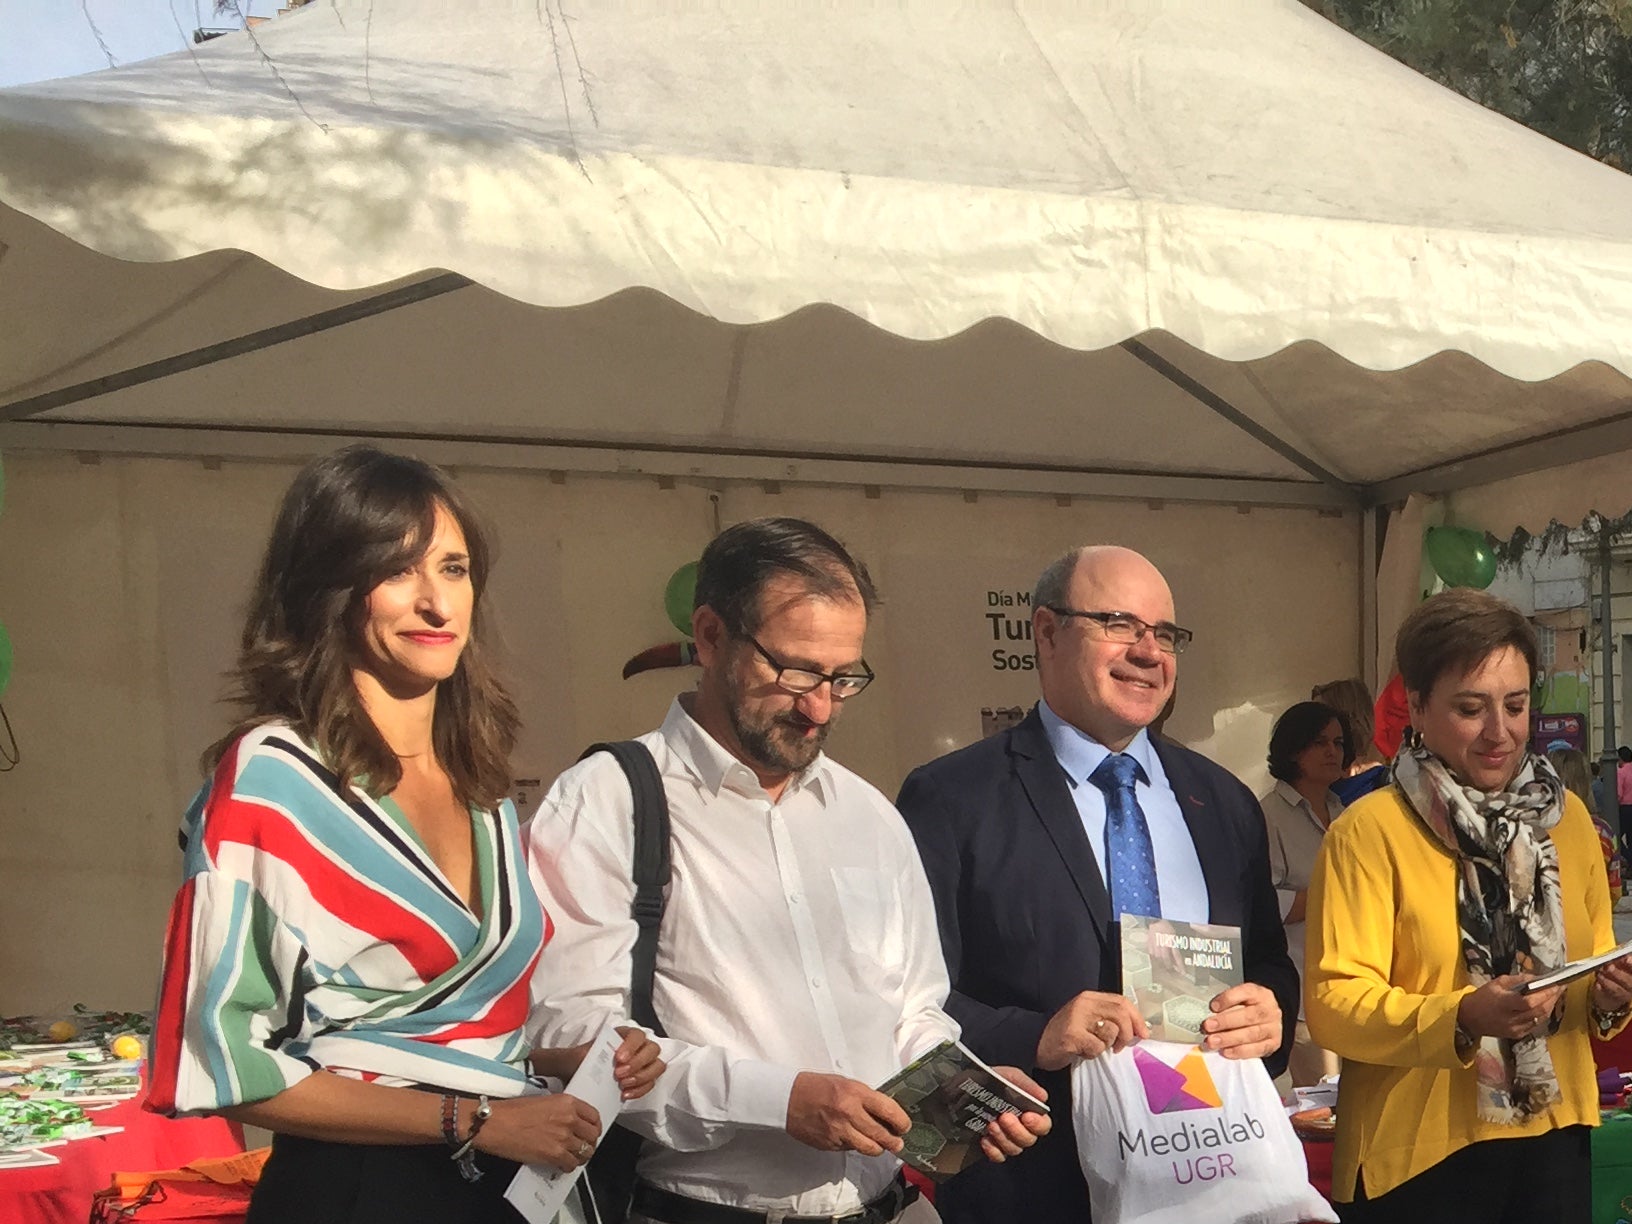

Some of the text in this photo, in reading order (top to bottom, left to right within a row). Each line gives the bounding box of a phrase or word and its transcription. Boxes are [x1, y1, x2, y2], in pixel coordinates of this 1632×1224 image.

[987, 590, 1034, 607] Día M
[1155, 932, 1232, 955] TURISMO INDUSTRIAL
[1192, 953, 1233, 970] ANDALUCÍA
[1118, 1112, 1265, 1161] Medialab
[1172, 1152, 1237, 1185] UGR
